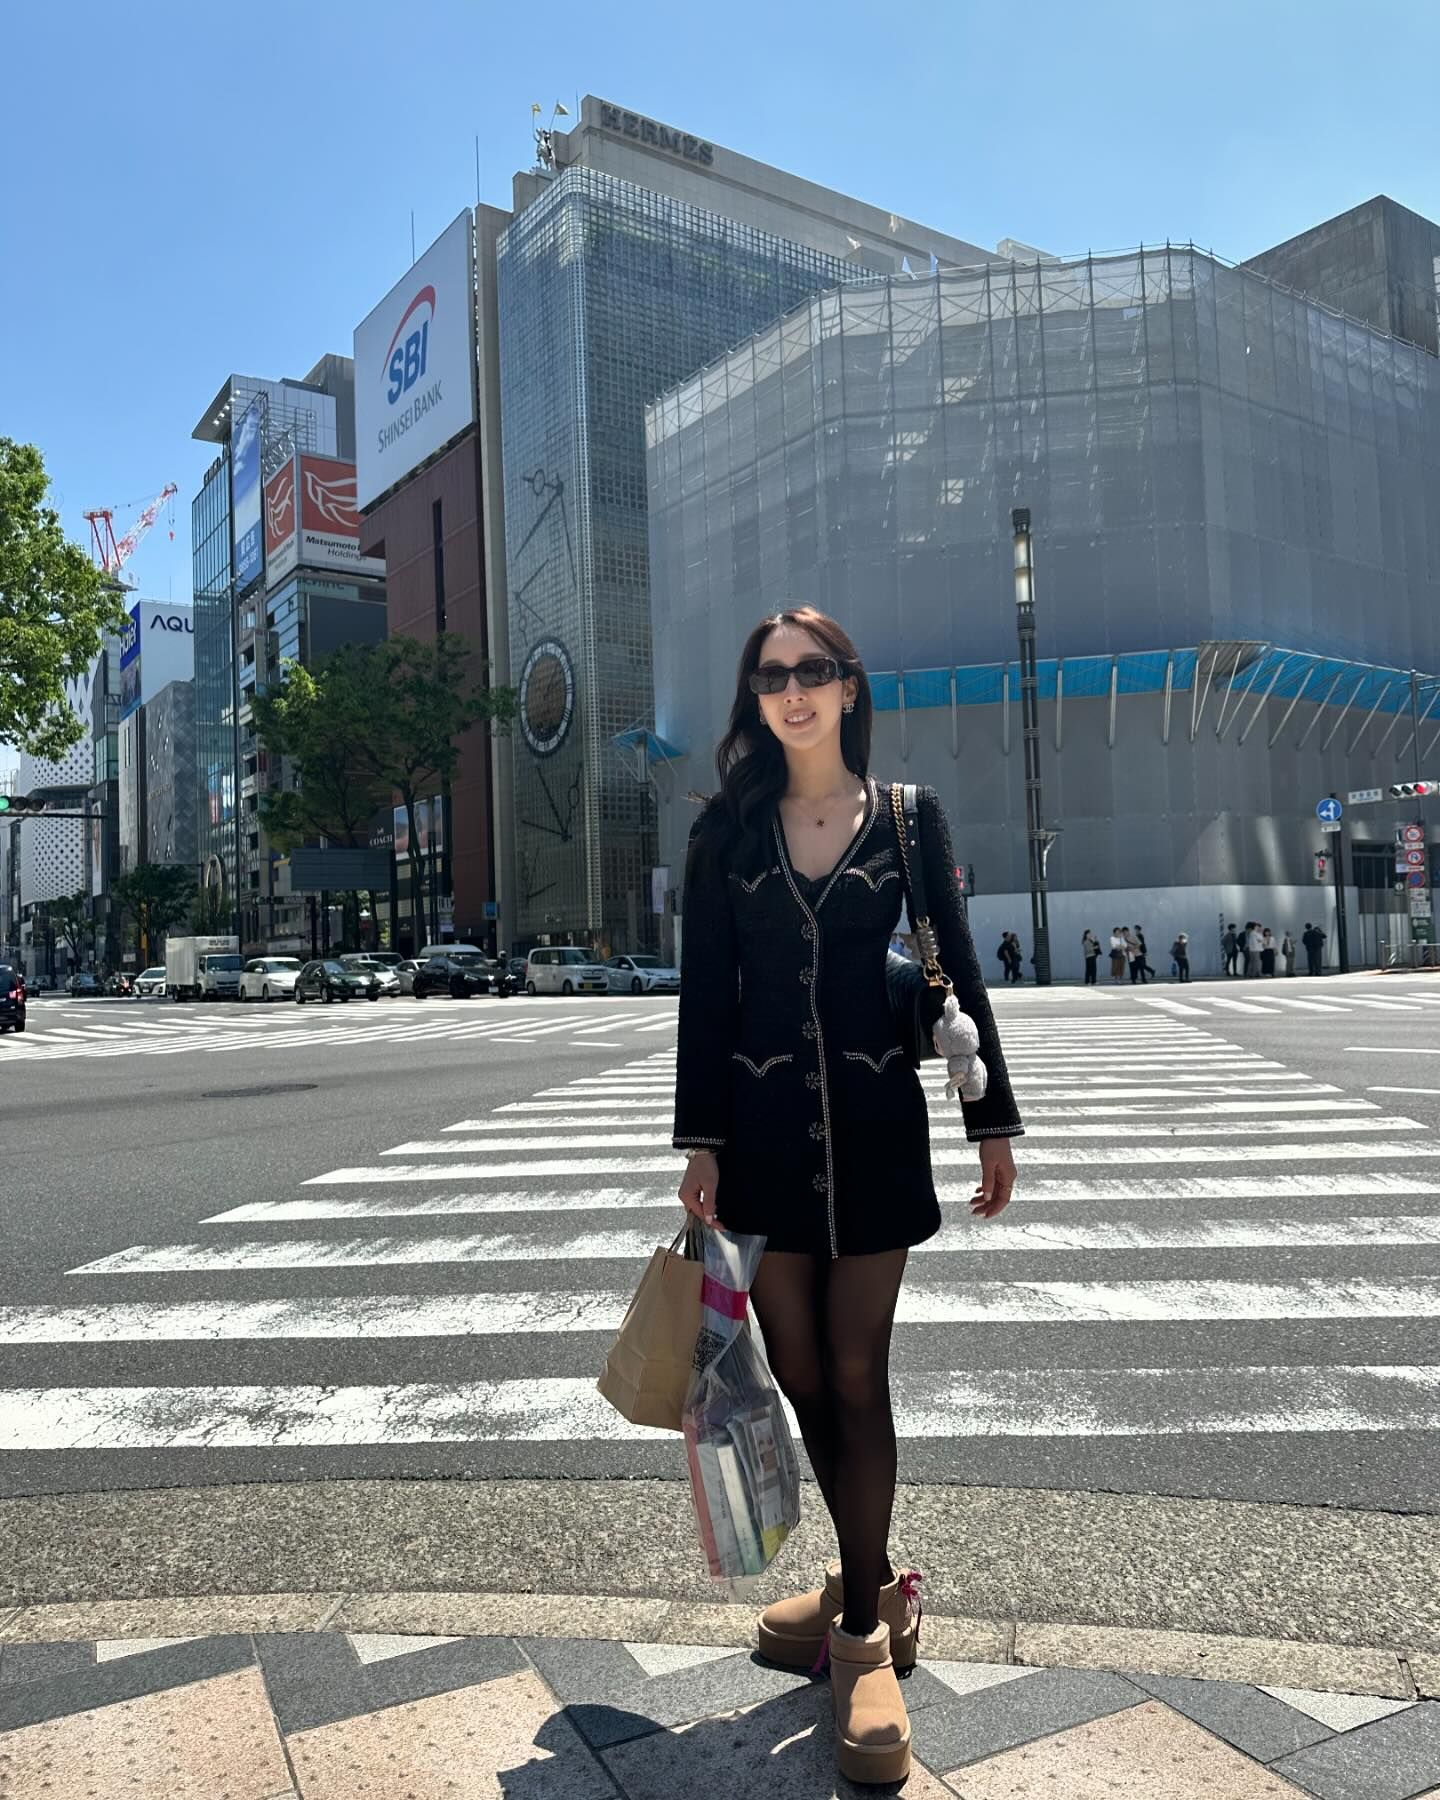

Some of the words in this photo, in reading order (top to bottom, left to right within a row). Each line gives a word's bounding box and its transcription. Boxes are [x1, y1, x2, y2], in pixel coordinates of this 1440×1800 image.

[387, 319, 429, 405] SBI
[377, 409, 414, 454] SHINSEI
[414, 380, 443, 423] BANK
[306, 535, 357, 551] Matsumoto
